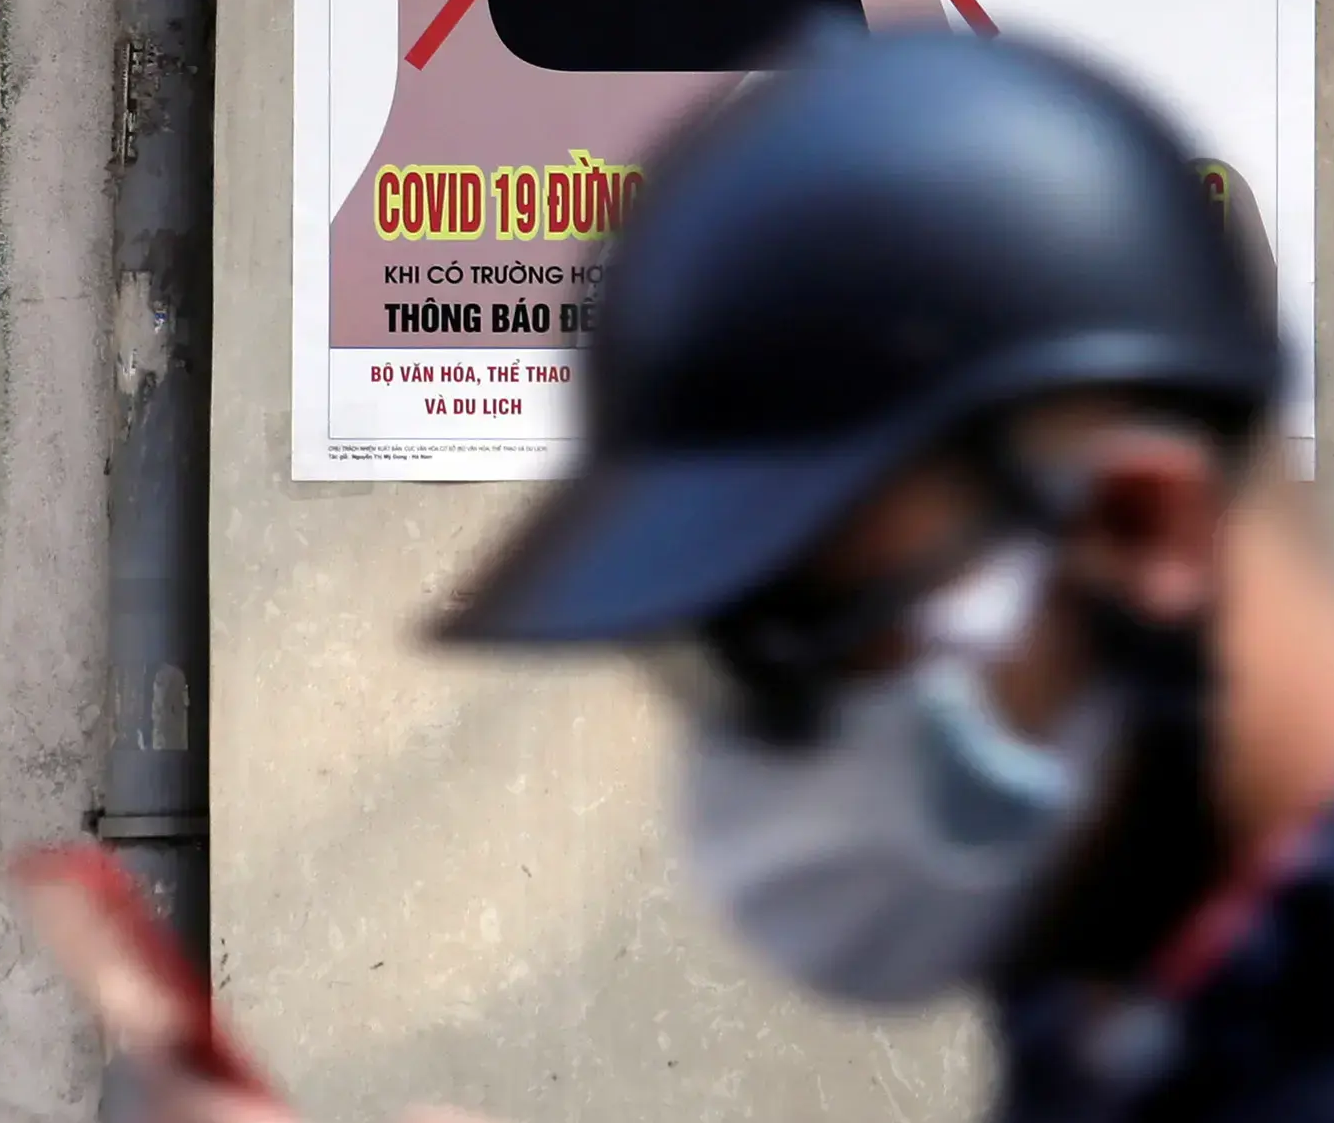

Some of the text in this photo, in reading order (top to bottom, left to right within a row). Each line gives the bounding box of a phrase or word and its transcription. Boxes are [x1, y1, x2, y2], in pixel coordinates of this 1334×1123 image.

[376, 168, 483, 238] COVID
[495, 168, 539, 238] 19
[384, 260, 604, 288] KHI CÓ TRƯỜNG HỢ
[384, 293, 598, 333] THÔNG BÁO ĐẾ
[370, 359, 571, 386] BỘ VĂN HÓA, THỂ THAO
[424, 394, 522, 419] VÀ DU LỊCH
